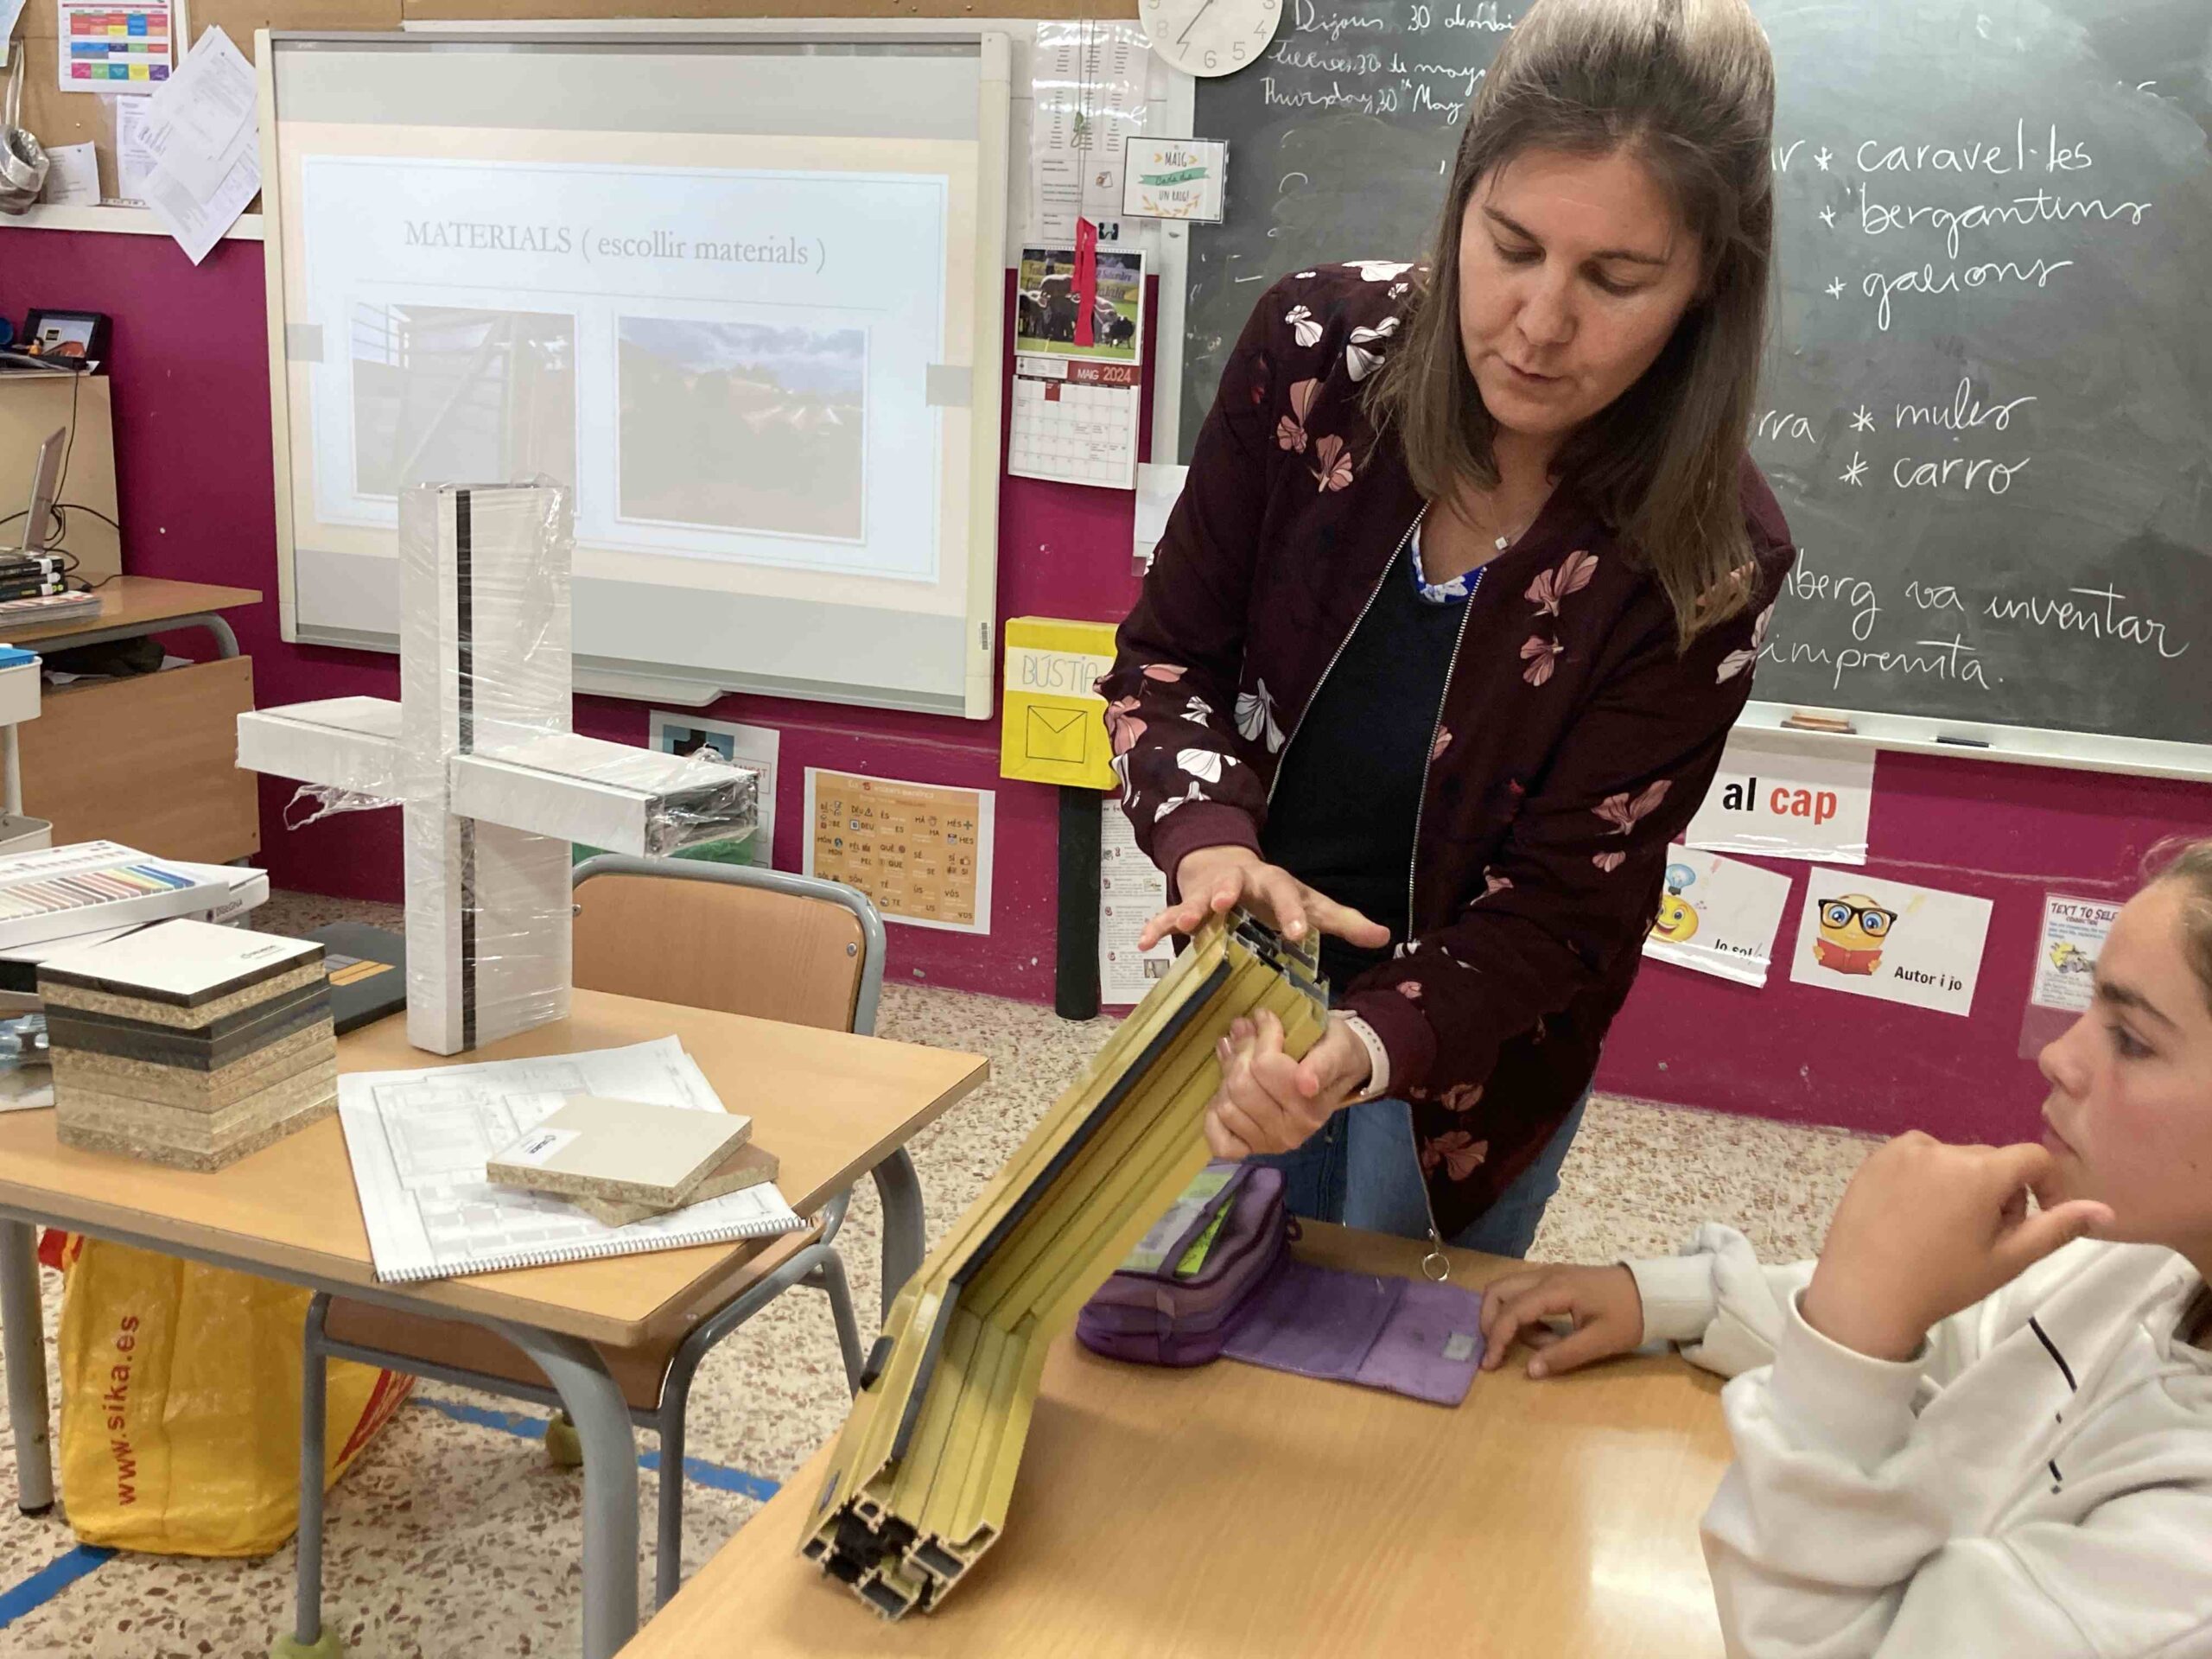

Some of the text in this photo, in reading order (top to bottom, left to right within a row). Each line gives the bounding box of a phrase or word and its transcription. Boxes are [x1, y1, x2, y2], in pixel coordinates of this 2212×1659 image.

[1156, 21, 1168, 38] 8
[1253, 20, 1267, 40] 4
[1177, 41, 1190, 60] 7
[1205, 50, 1217, 68] 6
[1232, 41, 1245, 60] 5
[1412, 84, 1464, 124] May
[1164, 151, 1187, 168] MAIG
[1159, 191, 1170, 200] UN
[1860, 182, 2152, 259] bergantins
[404, 220, 572, 254] MATERIALS
[598, 230, 686, 260] escollir
[695, 235, 810, 264] materials
[1863, 259, 2074, 331] galions
[1077, 368, 1099, 380] MAIG
[1103, 367, 1131, 383] 2024
[1896, 378, 2037, 429] mules
[1893, 457, 2031, 494] carro
[1905, 581, 1964, 611] va
[1984, 582, 2190, 658] inventar
[1723, 778, 1838, 825] al cap
[2050, 902, 2077, 916] TEXT
[2080, 906, 2094, 918] TO
[1894, 966, 1963, 993] Autor i jo
[101, 1314, 140, 1506] www.sika.es
